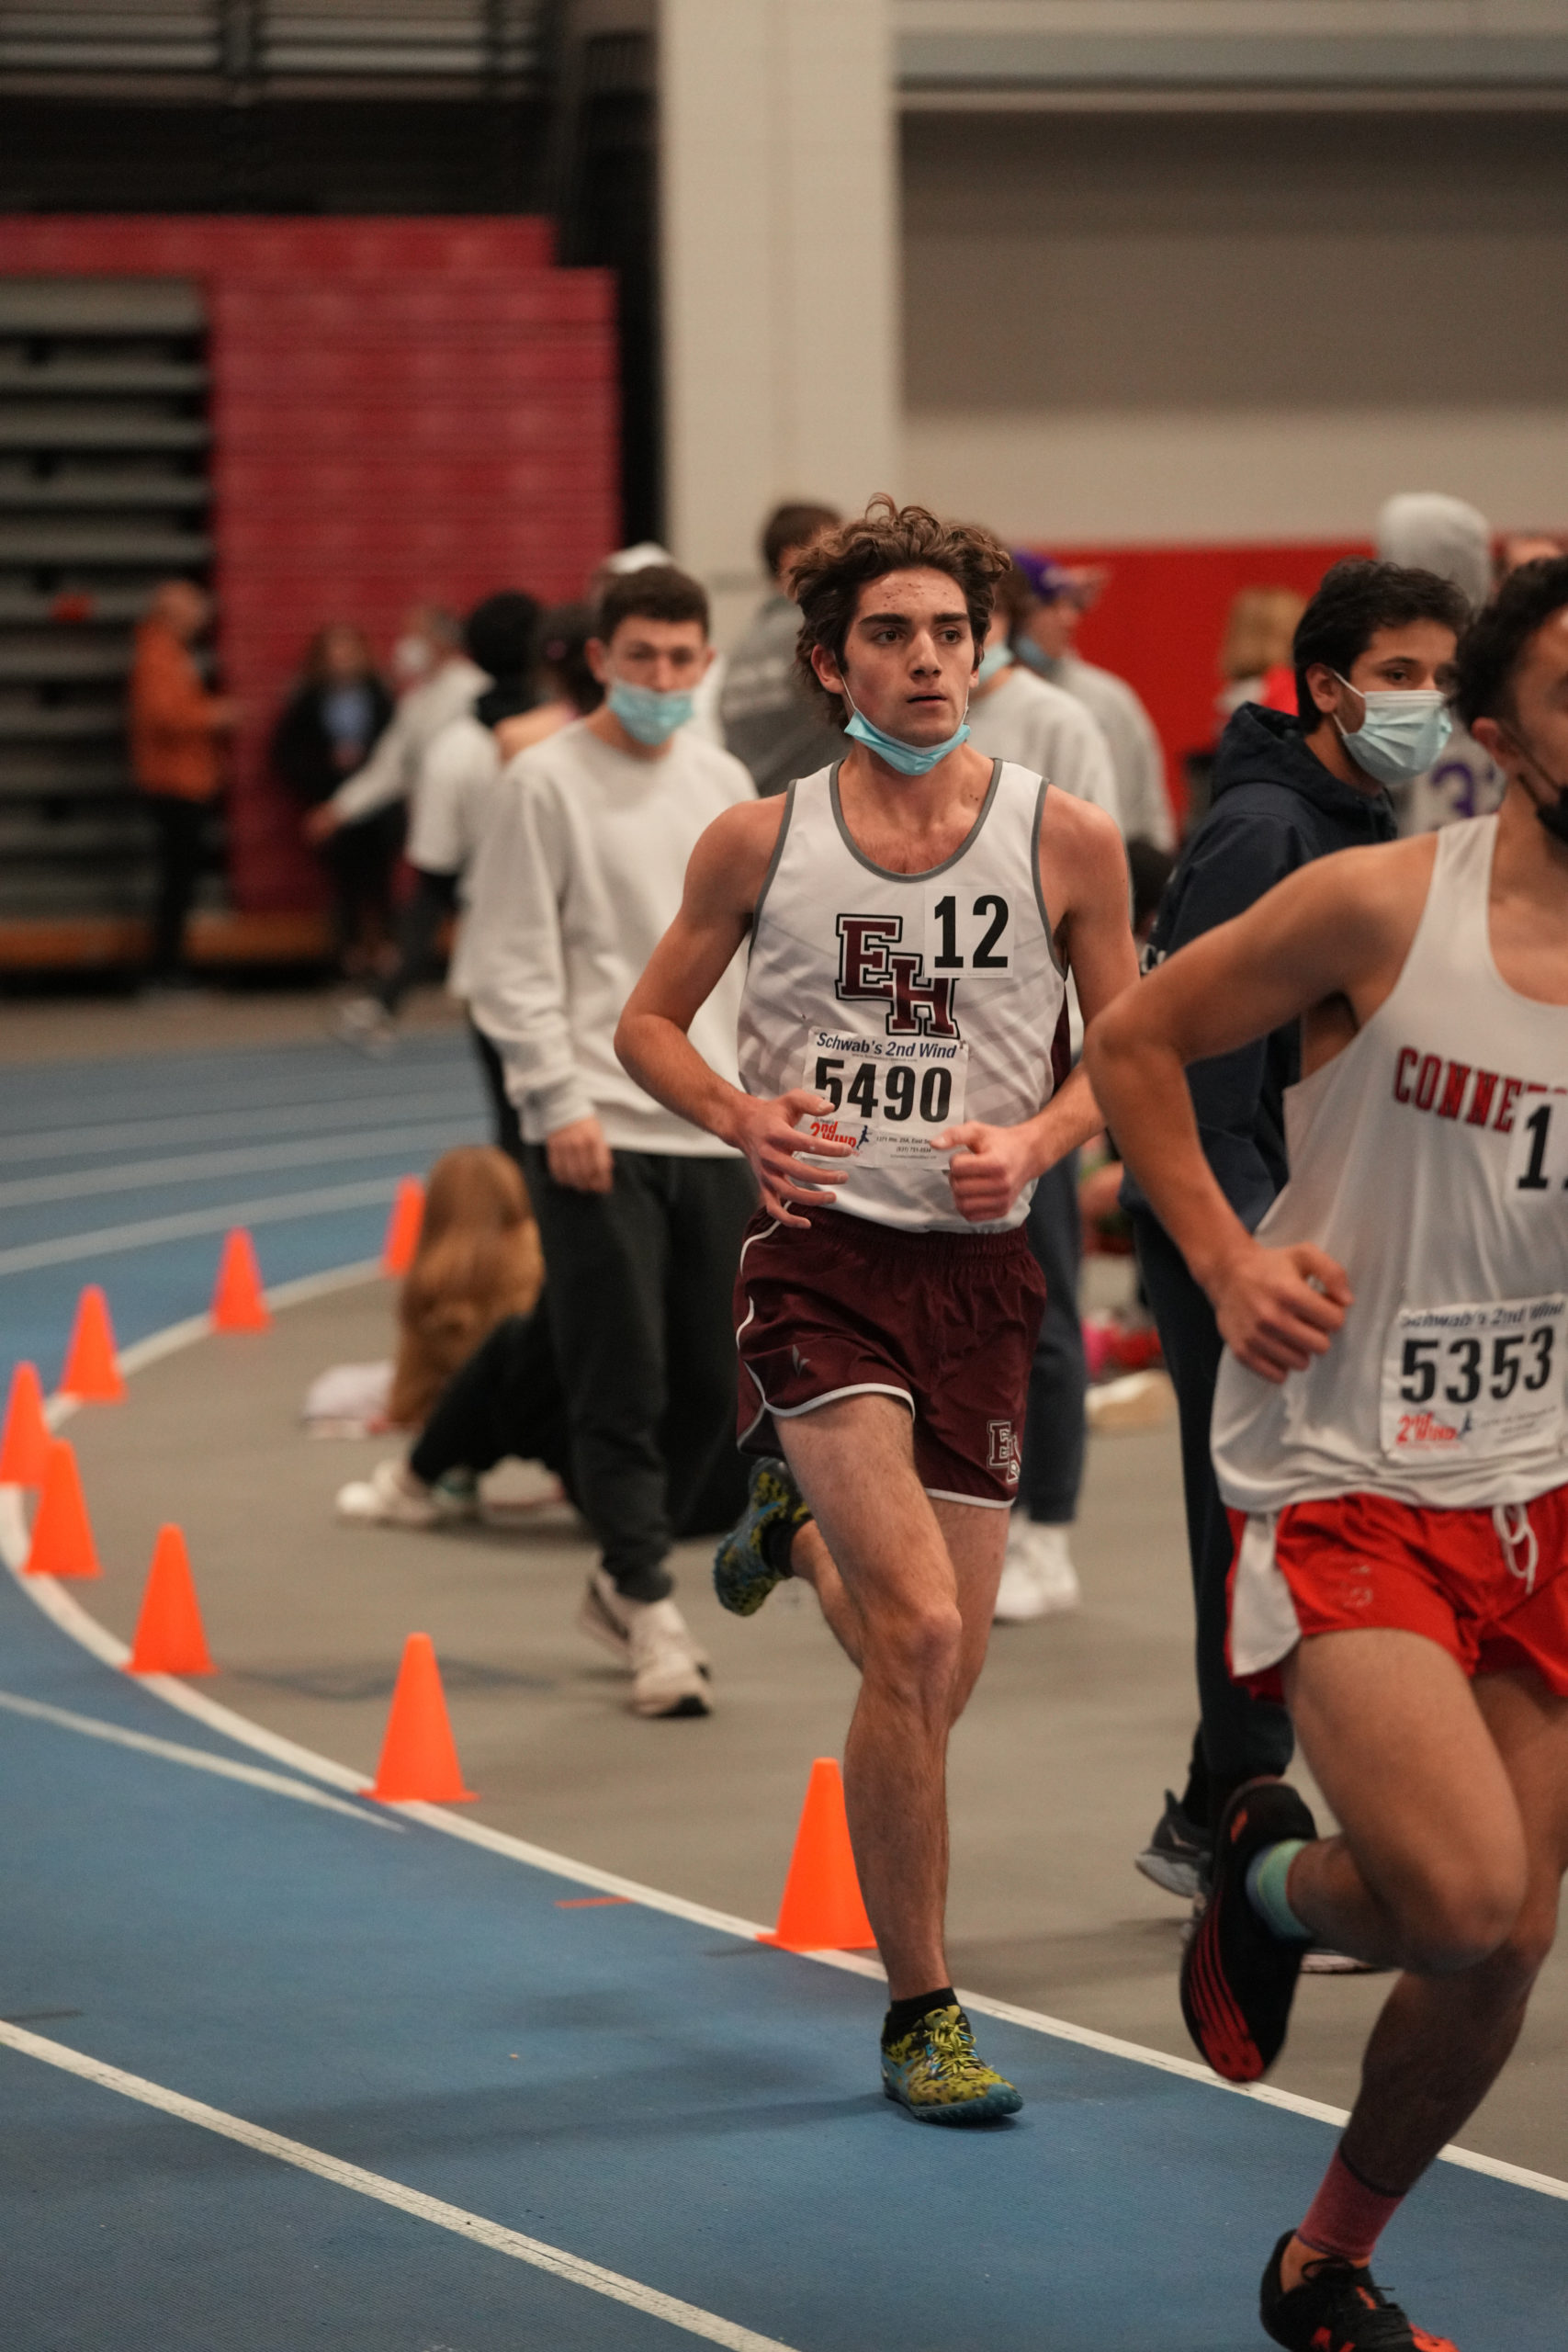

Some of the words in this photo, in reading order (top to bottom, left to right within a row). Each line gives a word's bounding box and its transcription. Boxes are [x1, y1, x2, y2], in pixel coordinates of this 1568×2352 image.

[934, 894, 1009, 968] 12
[837, 913, 960, 1039] EH
[817, 1032, 883, 1056] Schwab's
[886, 1041, 917, 1057] 2nd
[919, 1043, 957, 1058] Wind
[815, 1057, 953, 1122] 5490
[1394, 1046, 1567, 1134] CONNE
[1517, 1104, 1568, 1189] 1
[1401, 1325, 1554, 1404] 5353
